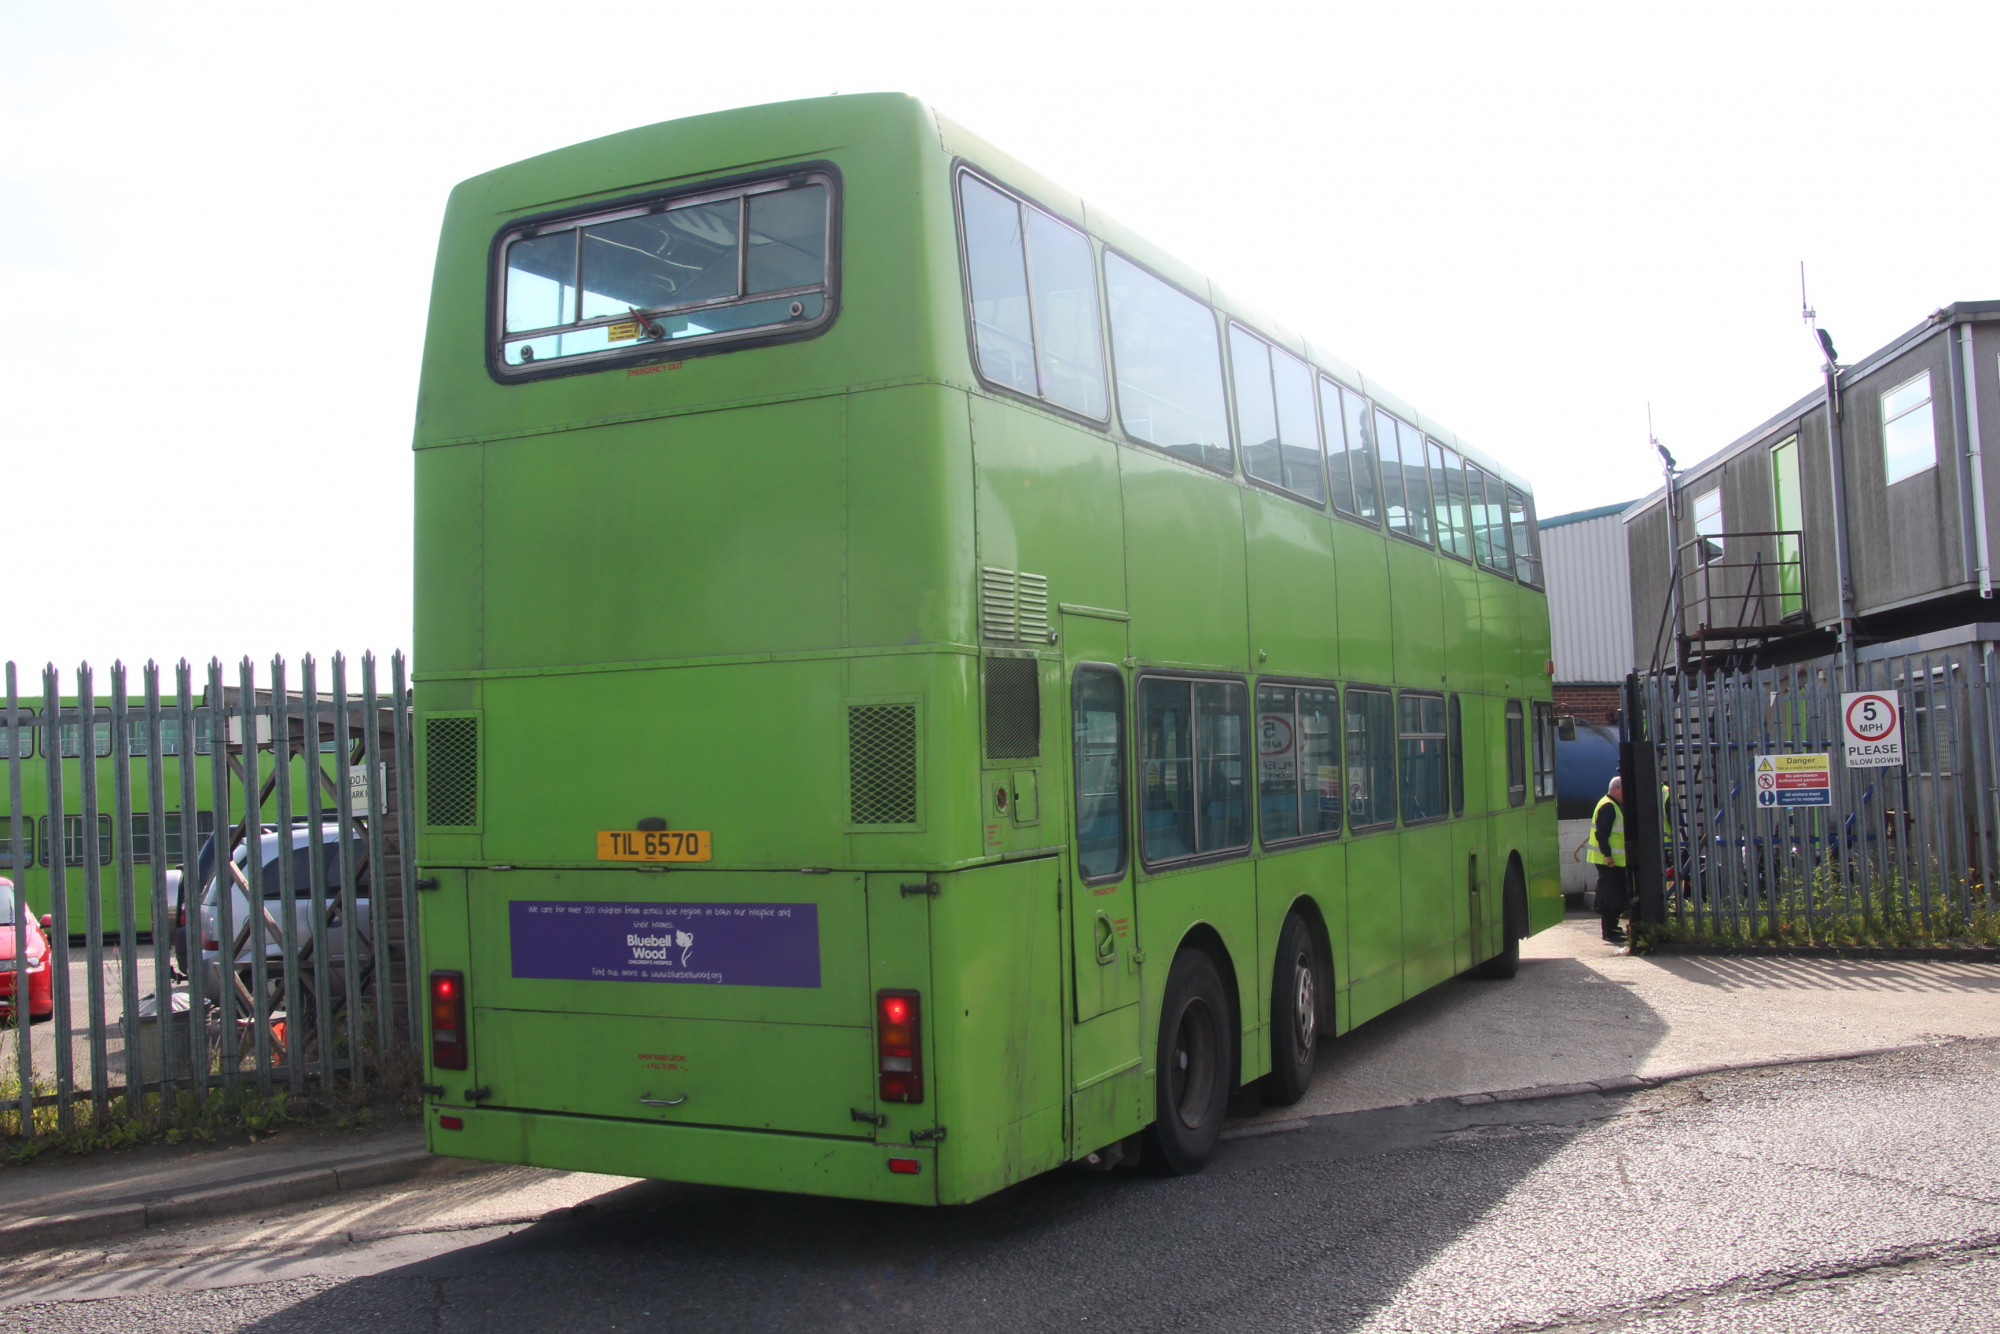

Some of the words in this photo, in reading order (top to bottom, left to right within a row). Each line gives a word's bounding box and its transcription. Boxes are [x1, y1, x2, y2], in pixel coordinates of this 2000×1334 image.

[628, 365, 666, 376] EMERGENCY
[669, 361, 683, 371] EXIT
[1863, 701, 1877, 721] 5
[1859, 723, 1883, 733] MPH
[1848, 744, 1898, 756] PLEASE
[1786, 756, 1816, 765] Danger
[1849, 758, 1873, 766] SLOW
[1874, 756, 1901, 765] DOWN
[350, 775, 361, 785] DO
[352, 790, 364, 799] ARK
[610, 832, 640, 856] TIL
[644, 832, 700, 856] 6570
[528, 905, 539, 914] We
[555, 904, 566, 914] for
[568, 907, 582, 915] over
[584, 905, 596, 915] 200
[598, 905, 623, 916] children
[625, 905, 641, 915] from
[643, 908, 664, 916] across
[666, 907, 678, 916] the
[706, 907, 713, 916] in
[715, 907, 732, 917] both
[734, 909, 746, 917] our
[749, 907, 776, 920] hospice
[778, 907, 791, 918] and
[633, 920, 649, 929] their
[627, 934, 671, 947] Bluebell
[633, 947, 666, 959] Wood
[592, 967, 606, 977] Find
[608, 968, 620, 977] out
[621, 969, 639, 978] more
[641, 970, 649, 978] at
[651, 970, 723, 983] www.bluebellwood.org
